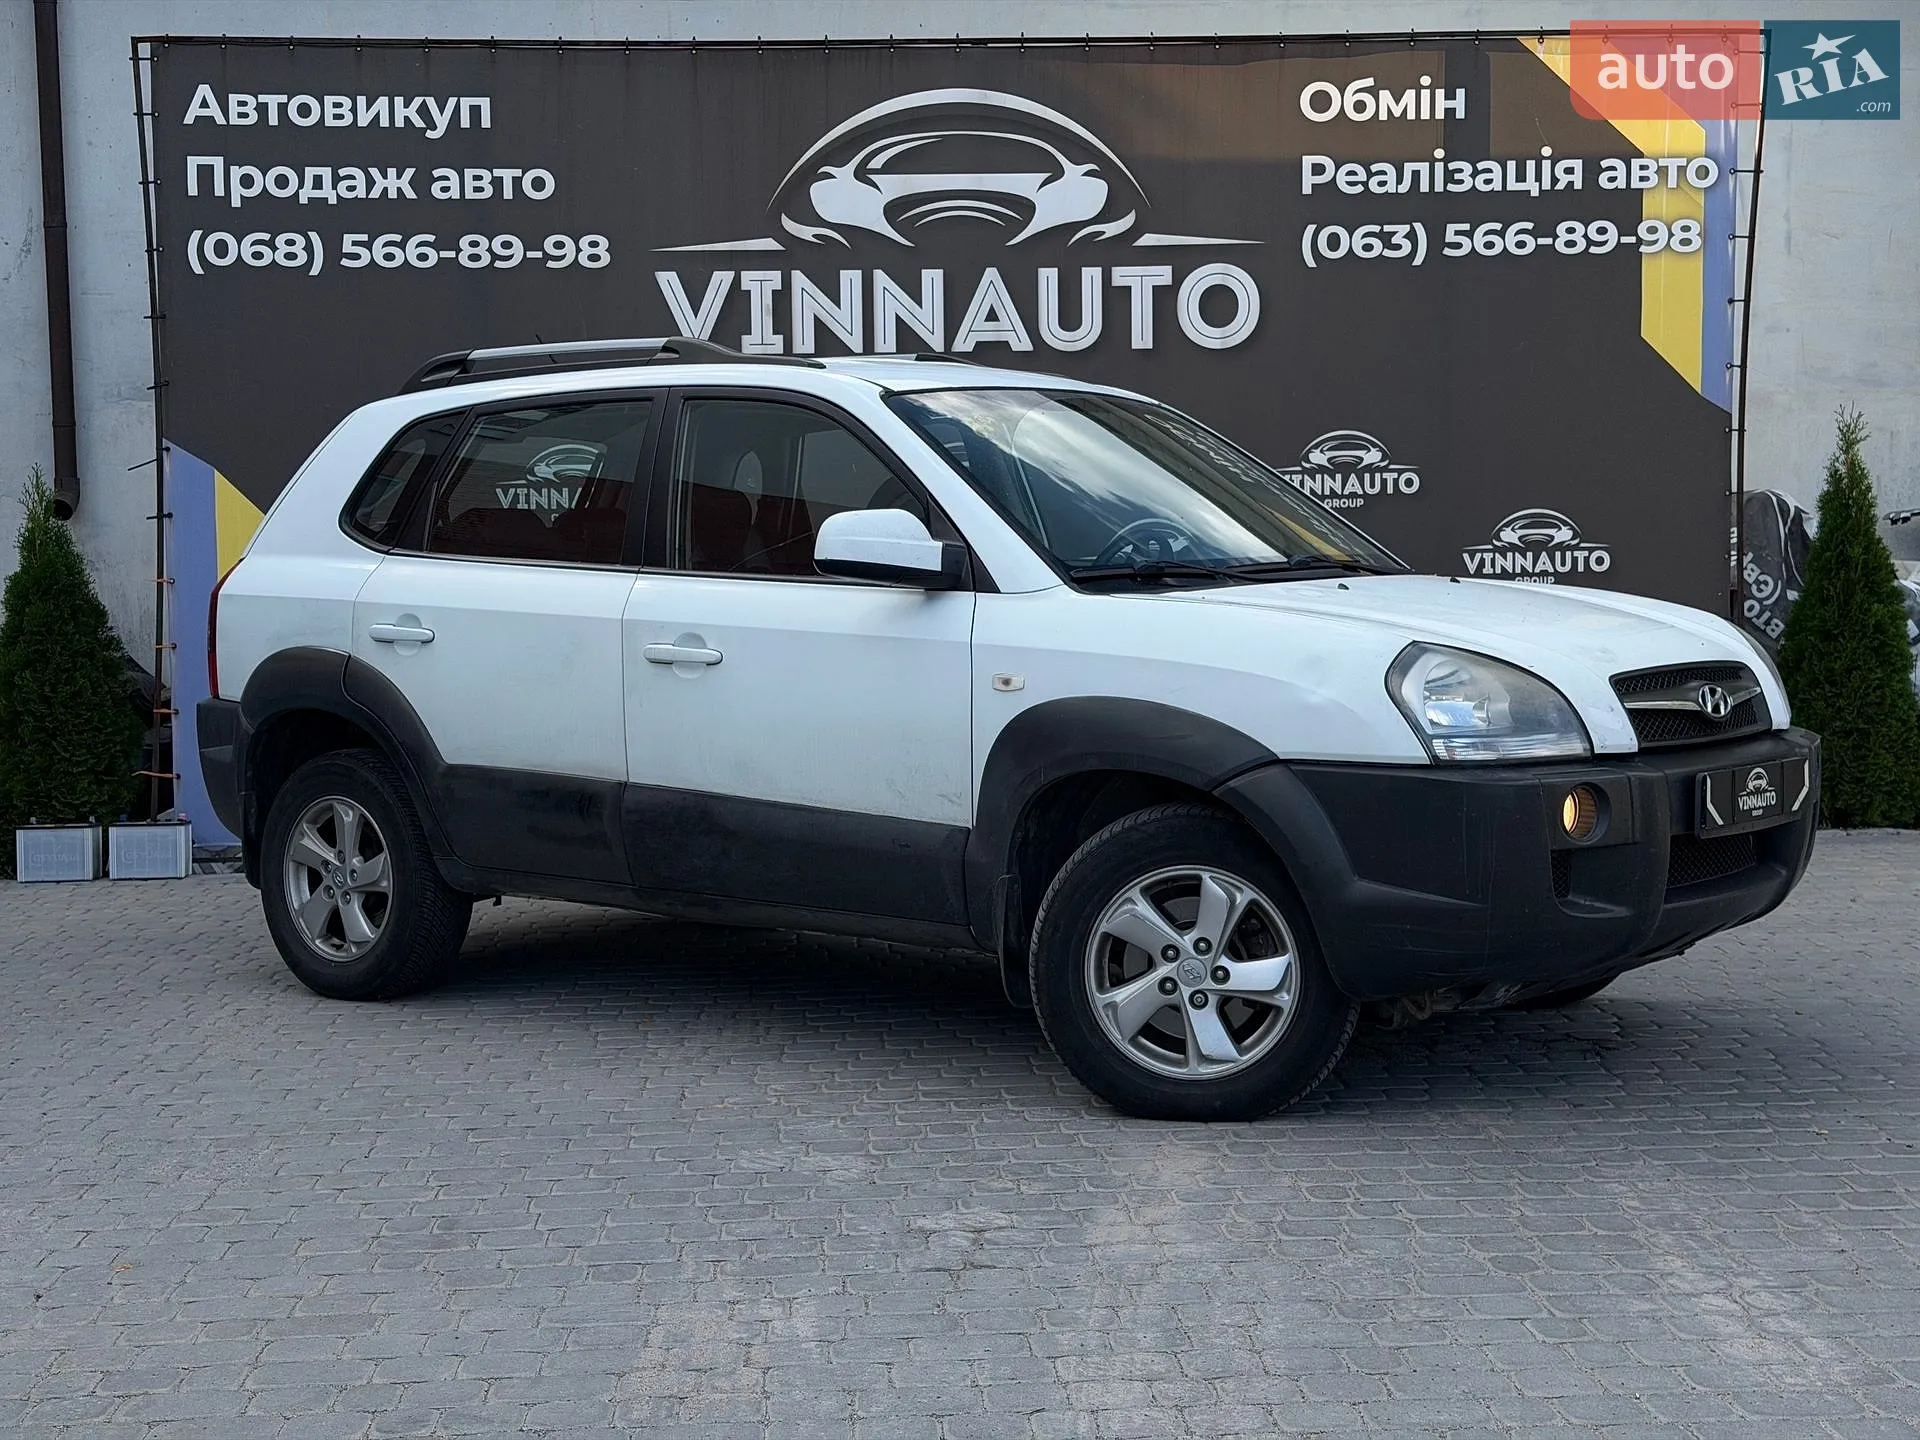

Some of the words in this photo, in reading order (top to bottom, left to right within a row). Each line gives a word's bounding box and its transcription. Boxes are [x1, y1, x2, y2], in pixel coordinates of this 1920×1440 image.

[183, 84, 491, 139] Автовикуп
[1300, 76, 1466, 122] Обмін
[186, 156, 418, 207] Продаж
[431, 168, 556, 200] авто
[1302, 146, 1583, 197] Реалізація
[1599, 156, 1719, 190] авто
[187, 230, 324, 275] (068)
[340, 234, 611, 269] 566-89-98
[1301, 223, 1428, 267] (063)
[1442, 219, 1702, 257] 566-89-98
[655, 263, 1261, 354] VINNAUTO
[1284, 472, 1420, 495] INNAUTO
[1462, 550, 1611, 575] VINNAUTO
[1737, 791, 1777, 811] VINNAUTO
